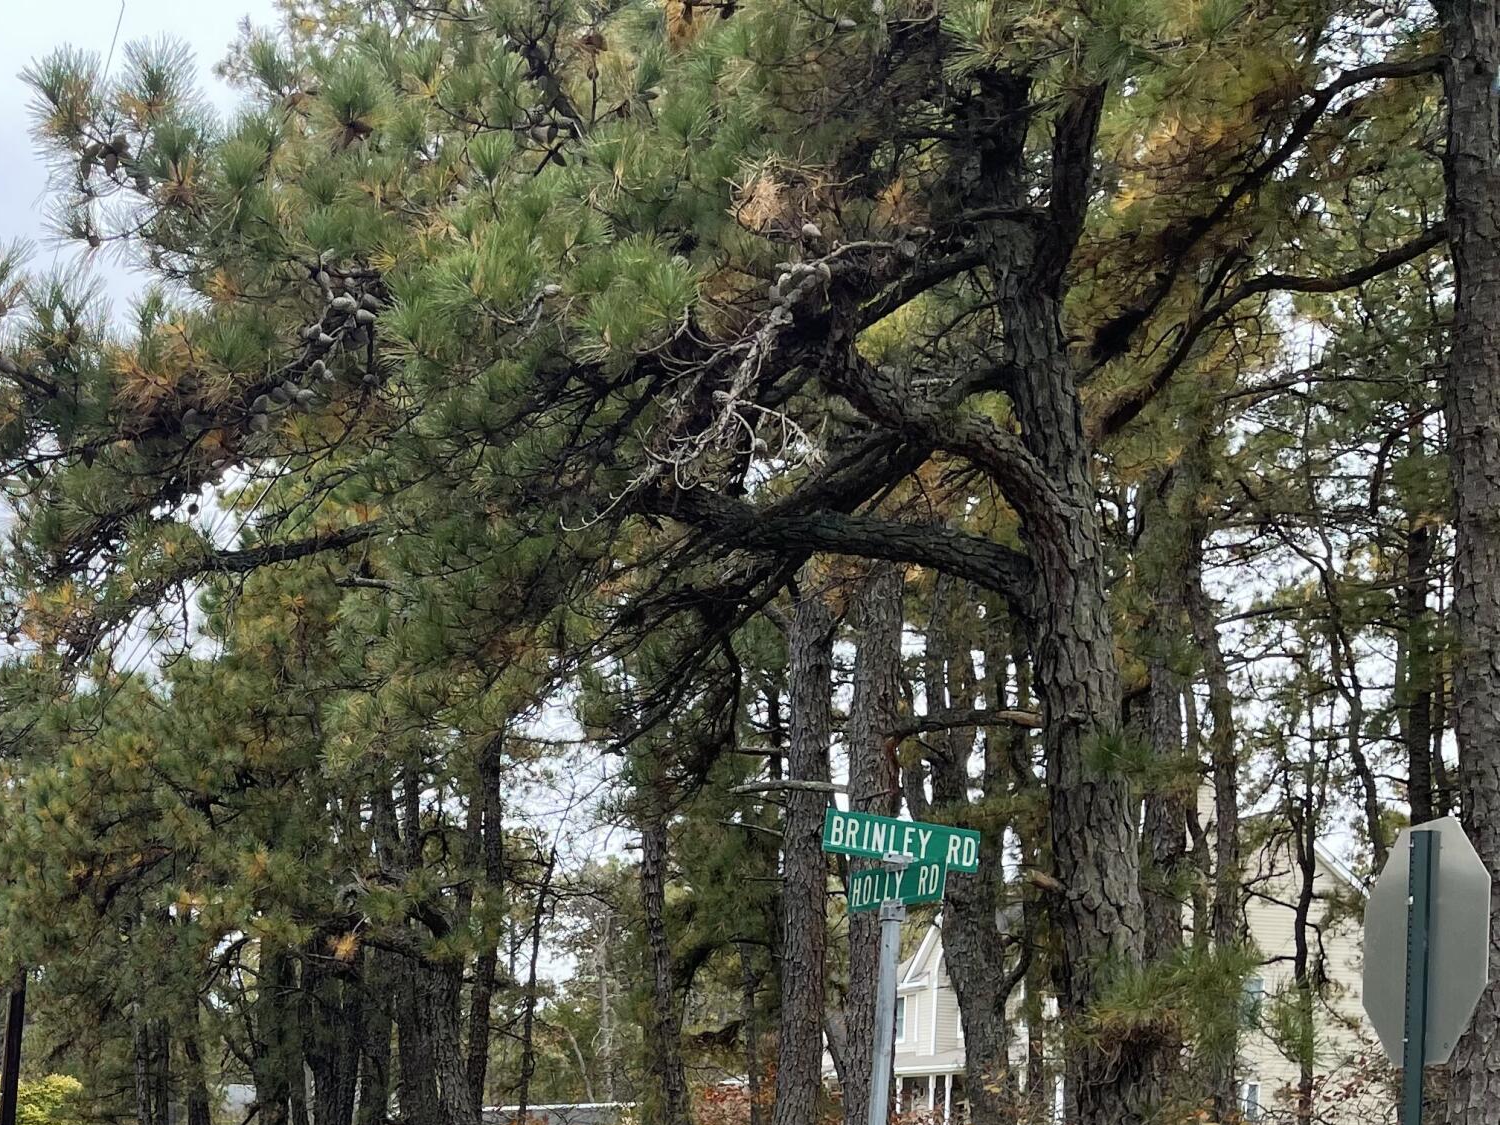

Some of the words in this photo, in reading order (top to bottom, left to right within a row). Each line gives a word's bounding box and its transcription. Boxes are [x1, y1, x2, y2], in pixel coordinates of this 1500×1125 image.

[830, 815, 933, 859] BRINLEY
[947, 834, 976, 867] RD
[851, 870, 904, 907] HOLLY
[917, 864, 940, 896] RD
